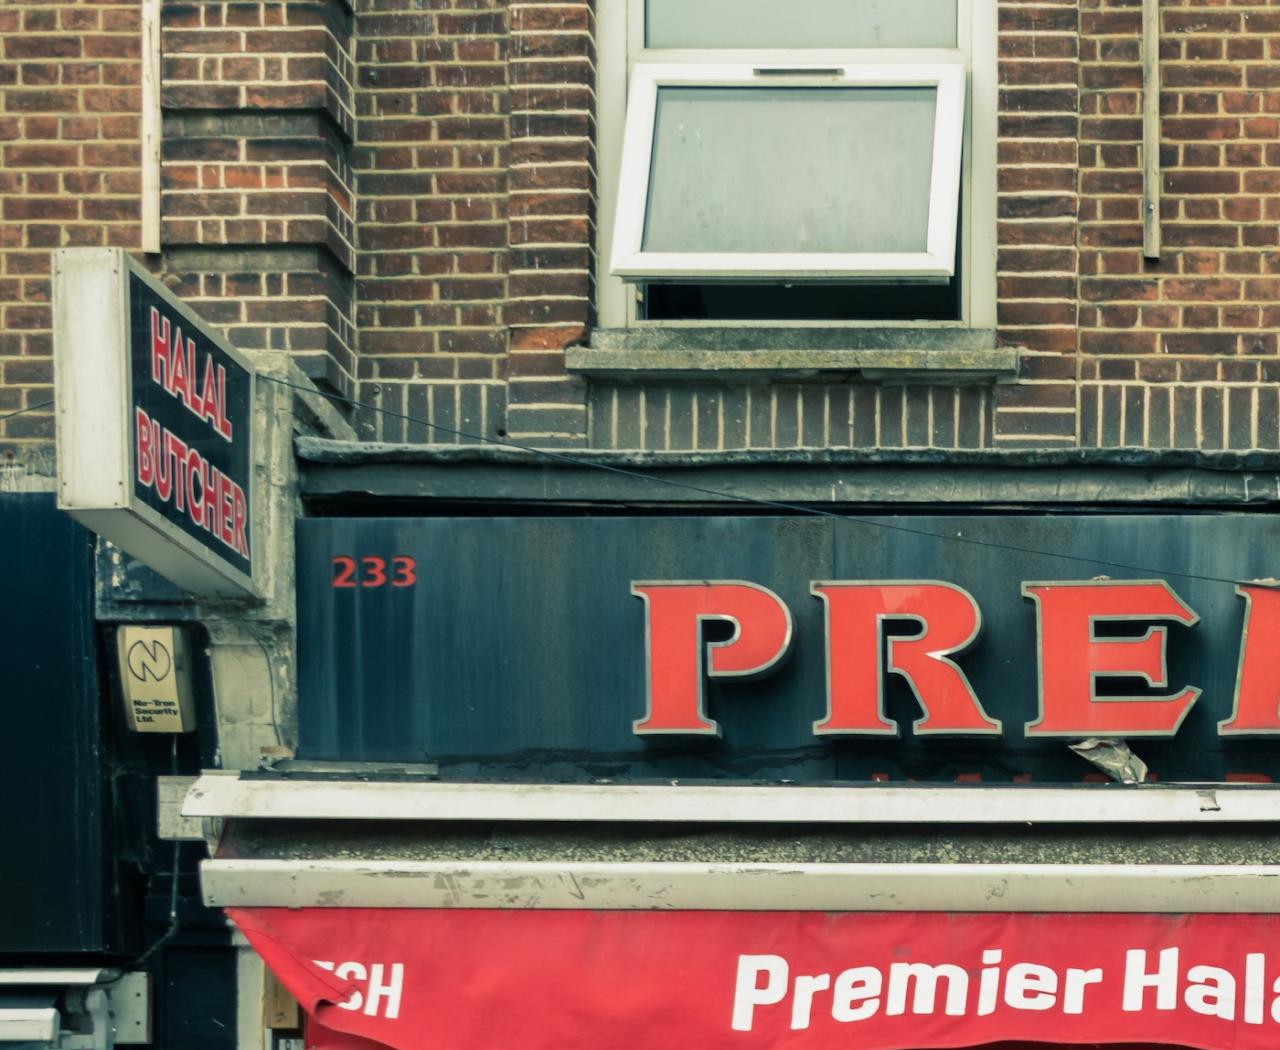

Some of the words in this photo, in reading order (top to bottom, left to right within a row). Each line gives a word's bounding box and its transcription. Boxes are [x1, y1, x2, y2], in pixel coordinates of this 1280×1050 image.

[150, 305, 233, 443] HALAL
[136, 405, 250, 561] BUTCHER
[331, 555, 417, 588] 233
[135, 708, 178, 716] Security
[731, 948, 1104, 1032] Premier
